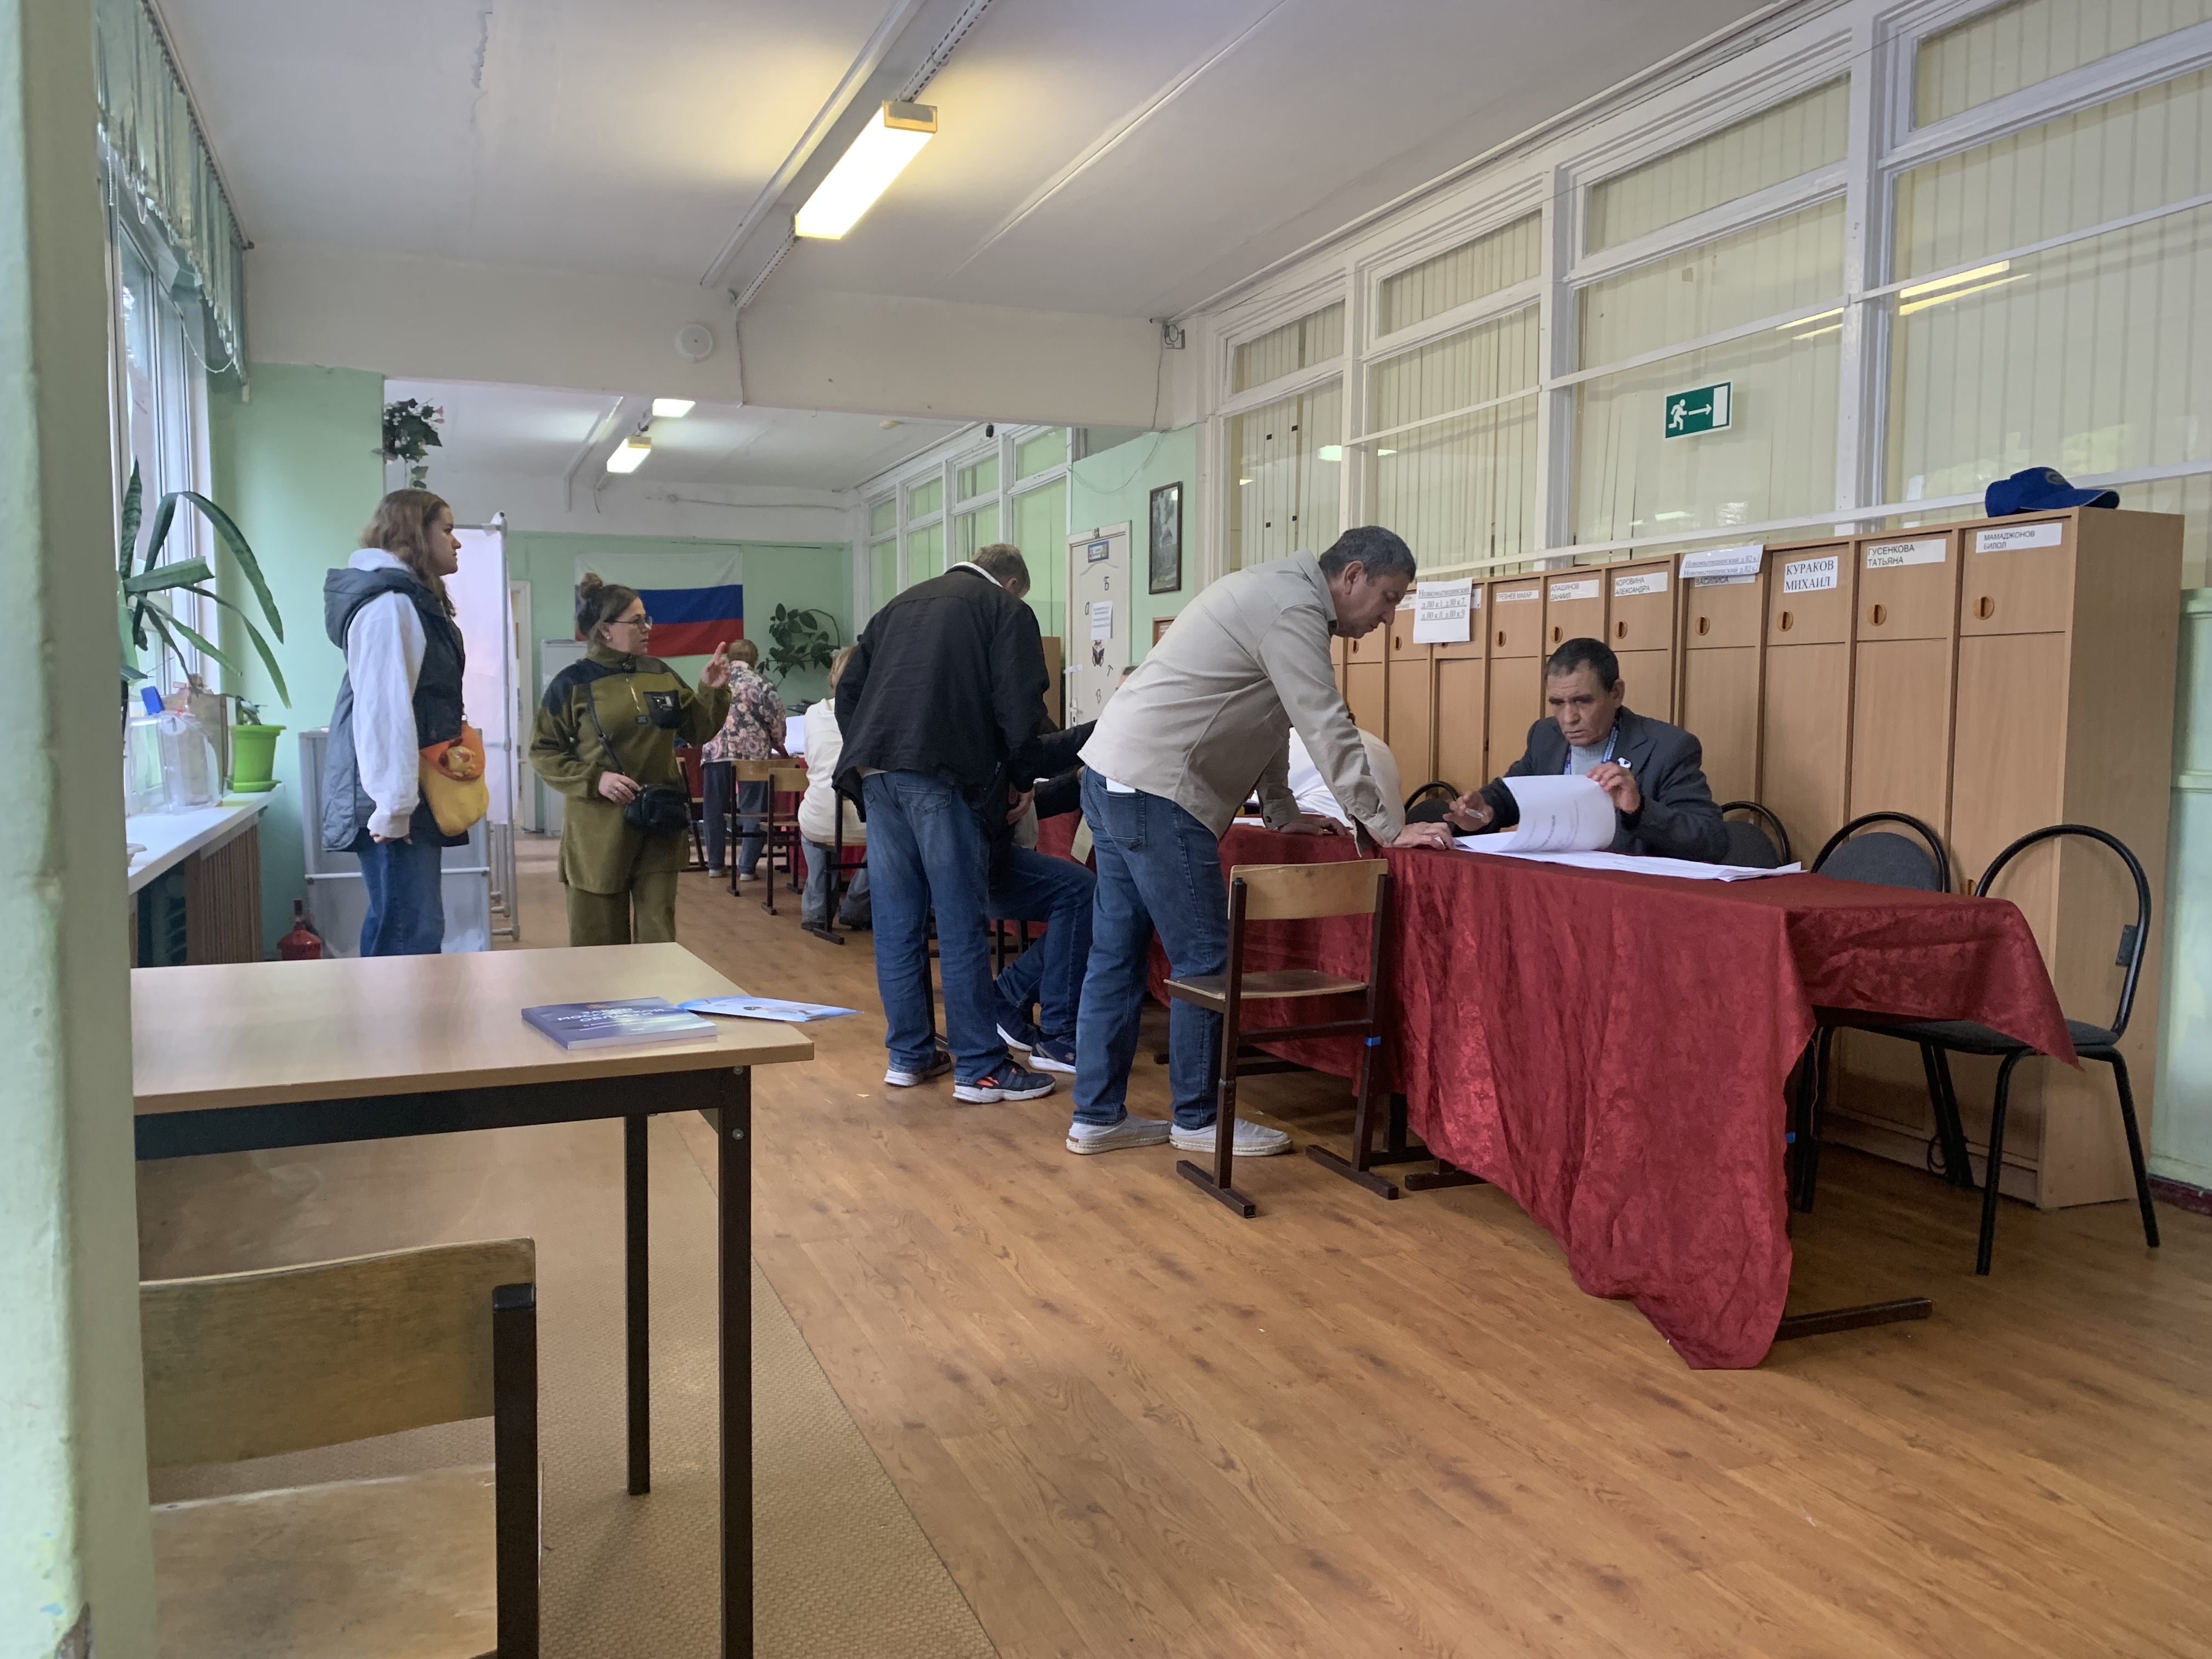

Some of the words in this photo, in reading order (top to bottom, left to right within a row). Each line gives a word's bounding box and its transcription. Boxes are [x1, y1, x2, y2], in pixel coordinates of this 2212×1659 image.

[1984, 531, 2035, 541] МАМАДЖОНОВ
[1868, 545, 1915, 556] ГУСЕНКОВА
[1984, 541, 2006, 550] БИЛОЛ
[1868, 556, 1904, 566] ТАТЬЯНА
[1786, 560, 1834, 575] КУРАКОВ
[1616, 577, 1645, 586] КОРОВИНА
[1696, 576, 1729, 585] ВАСИЛИСА
[1785, 576, 1830, 591] МИХАИЛ
[1616, 585, 1650, 595] АЛЕКСАНДРА
